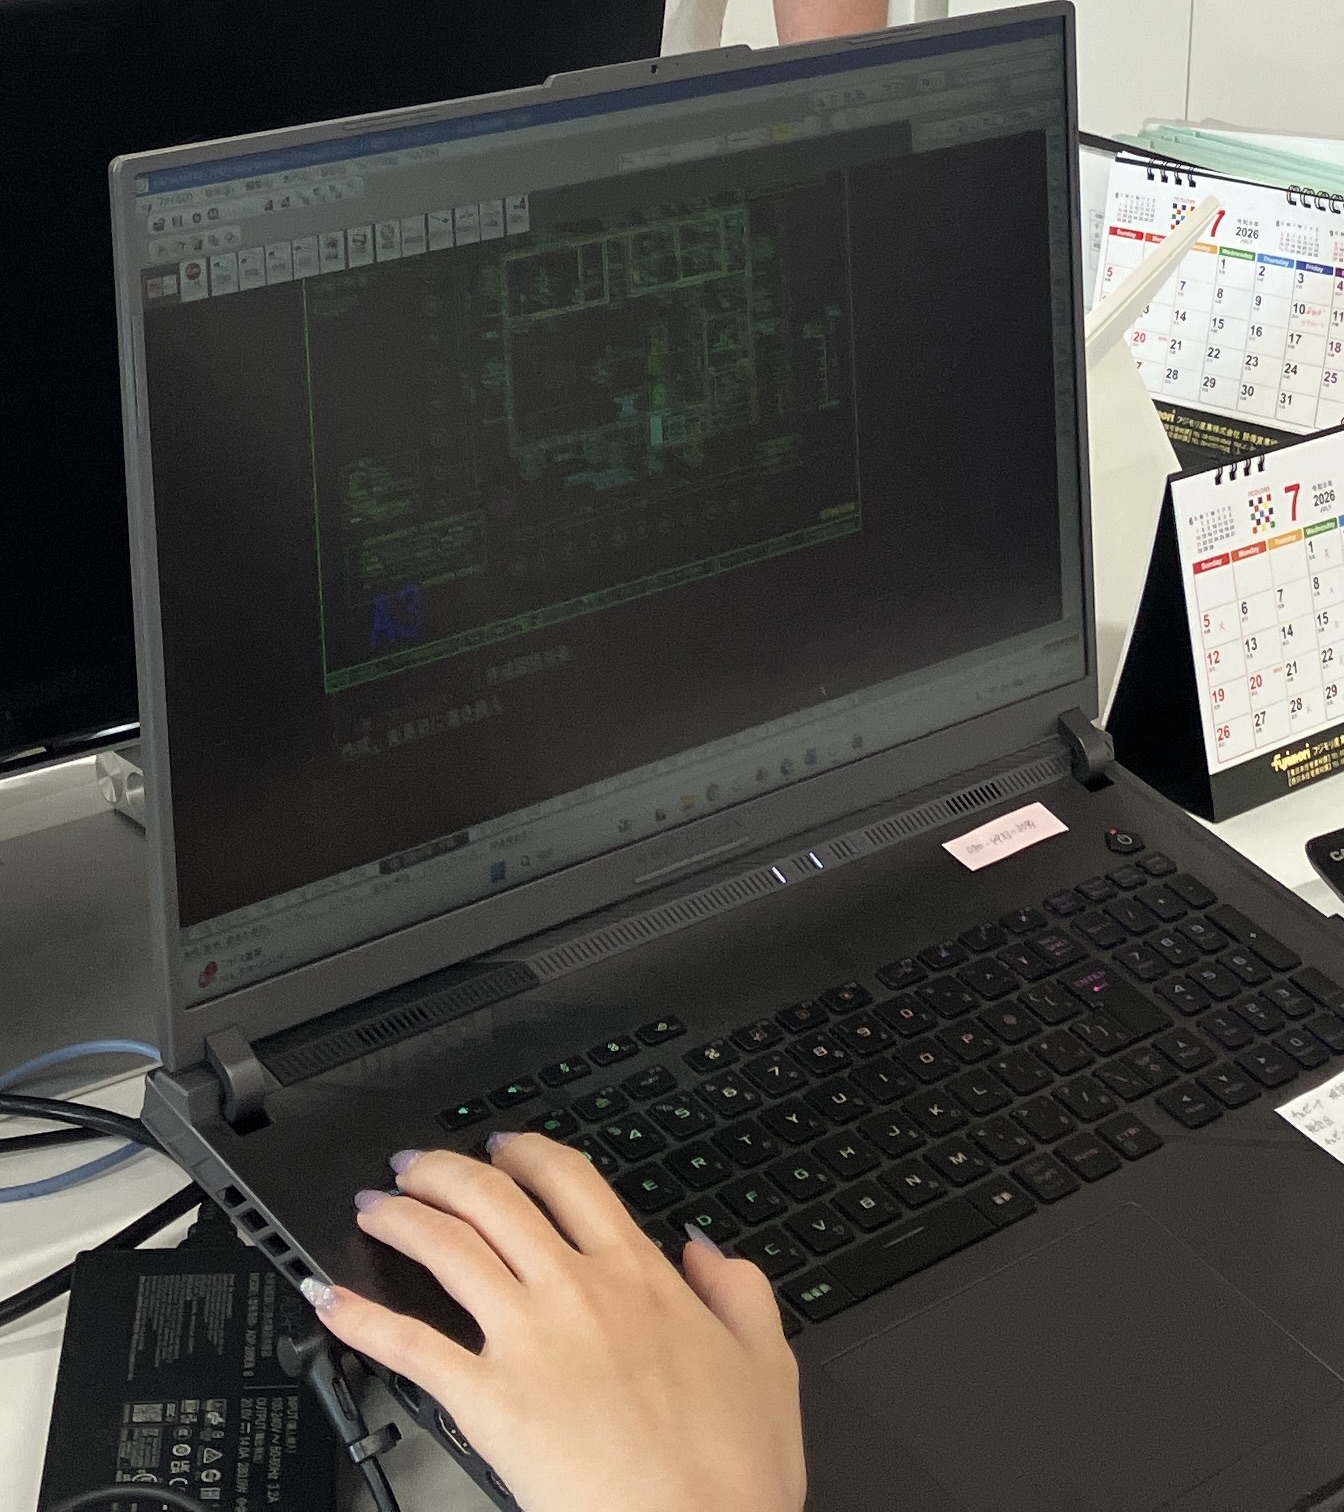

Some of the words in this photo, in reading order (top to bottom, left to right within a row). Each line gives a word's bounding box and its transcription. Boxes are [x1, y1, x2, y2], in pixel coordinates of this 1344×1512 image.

[1235, 226, 1259, 240] 2026
[1106, 266, 1113, 278] 5
[1180, 280, 1187, 291] 7
[1216, 287, 1224, 299] 8
[1254, 295, 1262, 307] 9
[1293, 302, 1306, 315] 10
[1332, 310, 1344, 323] 11
[1221, 258, 1226, 270] 1
[1258, 265, 1266, 277] 2
[1297, 272, 1305, 284] 3
[1336, 280, 1344, 292] 4
[1174, 309, 1187, 322] 14
[1212, 317, 1225, 330] 15
[1250, 324, 1263, 338] 16
[1289, 332, 1302, 345] 17
[1328, 340, 1342, 354] 18
[1133, 331, 1146, 343] 20
[1169, 338, 1182, 351] 21
[1206, 346, 1221, 360] 22
[1245, 354, 1259, 368] 23
[1283, 362, 1298, 375] 24
[1323, 370, 1338, 384] 25
[1165, 368, 1179, 381] 28
[1202, 376, 1216, 389] 29
[1240, 384, 1255, 397] 30
[1279, 392, 1293, 406] 31
[1284, 483, 1301, 522] 7
[1313, 489, 1336, 507] 2026
[1308, 540, 1314, 554] 1
[1203, 613, 1211, 628] 5
[1241, 601, 1248, 615] 6
[1276, 588, 1284, 602] 7
[1312, 576, 1320, 590] 8
[1206, 650, 1221, 666] 12
[1244, 637, 1258, 653] 13
[1281, 623, 1294, 639] 14
[1316, 611, 1329, 626] 15
[1212, 688, 1225, 704] 19
[1249, 674, 1263, 691] 20
[1285, 660, 1298, 677] 21
[1320, 647, 1334, 664] 22
[1216, 725, 1231, 742] 26
[1253, 710, 1266, 728] 27
[1289, 697, 1303, 714] 28
[1325, 684, 1338, 700] 29
